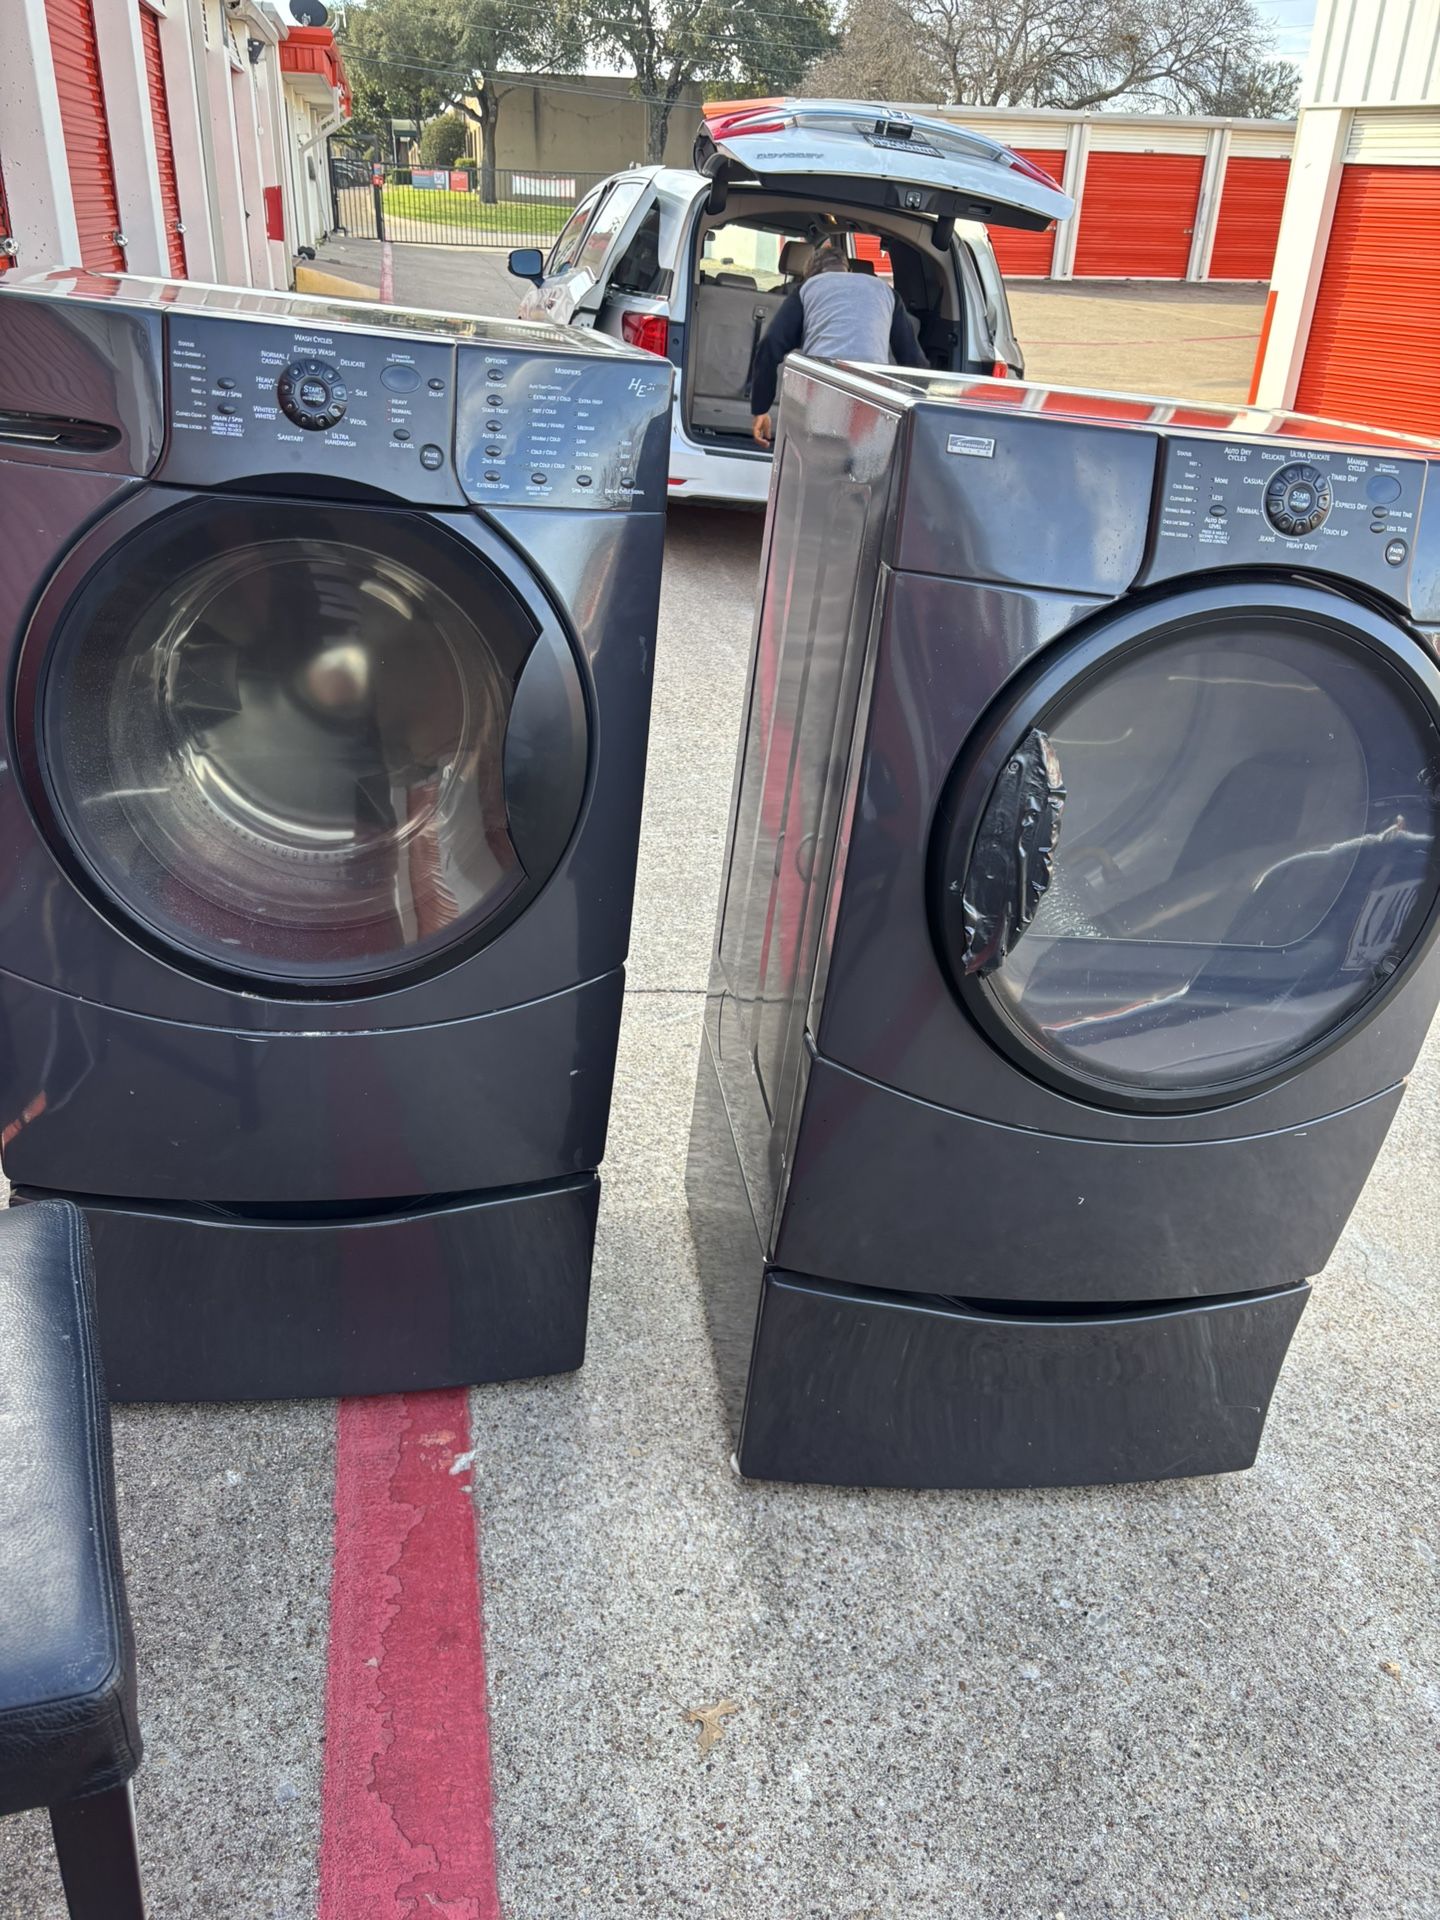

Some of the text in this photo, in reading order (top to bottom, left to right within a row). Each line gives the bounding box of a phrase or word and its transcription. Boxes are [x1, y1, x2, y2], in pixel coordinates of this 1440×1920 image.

[294, 334, 333, 345] WASH CYCLES
[294, 345, 336, 356] EXPRESS WASH
[261, 351, 286, 360] NORMAL
[261, 358, 283, 366] CASUAL
[340, 359, 366, 368] DELICATE
[484, 357, 508, 365] OPTIONS
[255, 376, 275, 384] HEAVY
[355, 389, 368, 397] SILK
[253, 405, 278, 414] WHITEST
[350, 418, 367, 426] WOOL
[277, 433, 304, 442] SANITARY
[332, 432, 349, 440] ULTRA
[1224, 447, 1253, 456] AUTO DRY
[1290, 450, 1331, 461] ULTRA DELICATE
[1227, 454, 1247, 462] CYCLES
[1261, 452, 1286, 461] DELICATE
[1346, 457, 1369, 466] MANUAL
[1348, 464, 1366, 473] CYCLES
[1214, 477, 1228, 485] MORE
[1243, 477, 1264, 485] CASUAL
[1330, 473, 1345, 481] TIMED
[1237, 506, 1260, 515] NORMAL
[1335, 501, 1368, 511] EXPRESS DRY
[1218, 517, 1228, 525] DRY
[1323, 527, 1349, 537] TOUCH UP
[1258, 535, 1275, 543] JEANS
[1286, 542, 1318, 551] HEAVY DUTY
